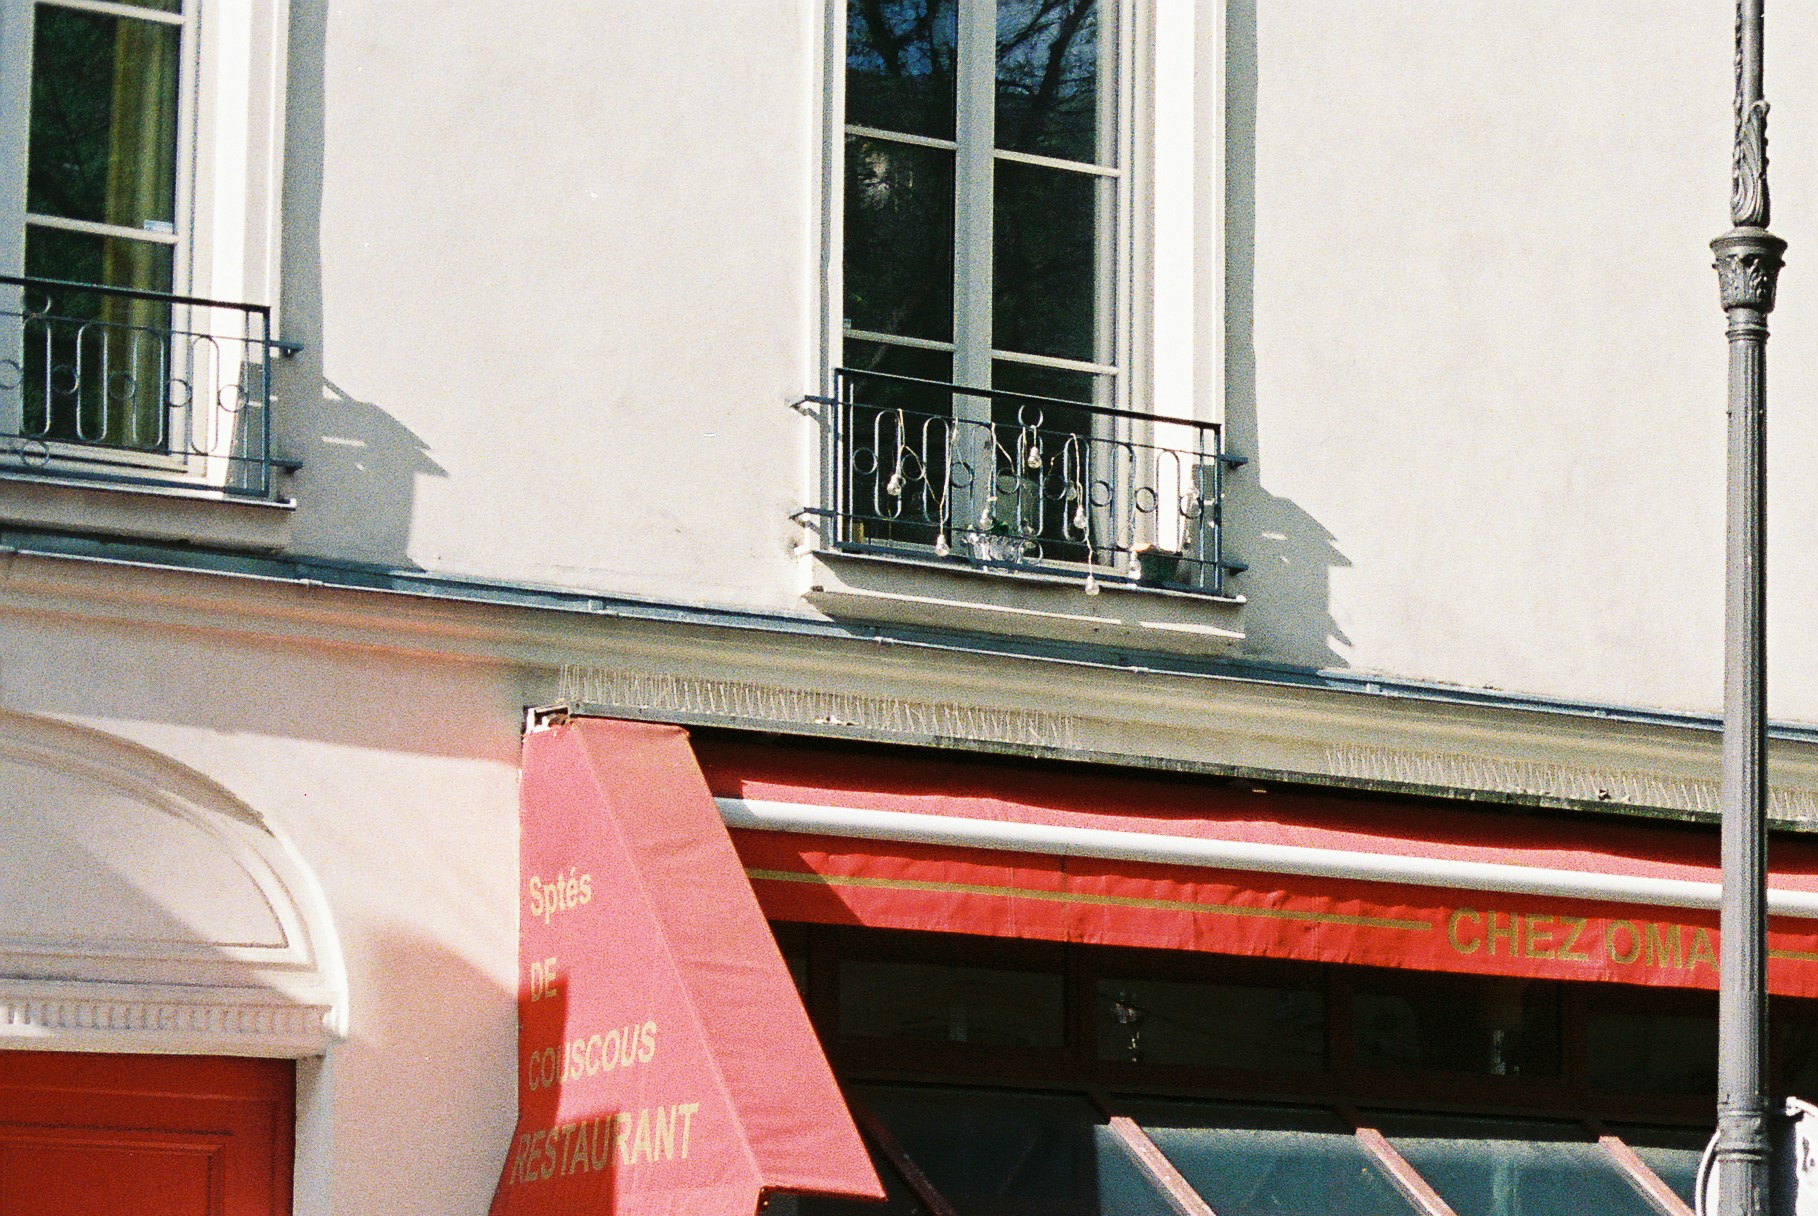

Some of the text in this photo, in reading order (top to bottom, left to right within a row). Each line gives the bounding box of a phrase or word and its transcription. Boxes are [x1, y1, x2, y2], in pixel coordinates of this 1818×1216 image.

[529, 869, 592, 924] Sptés
[1448, 907, 1720, 972] CHEZ OMA
[530, 957, 557, 1002] DE
[529, 1020, 658, 1091] COUSCOUS
[509, 1102, 699, 1187] RESTAURANT
